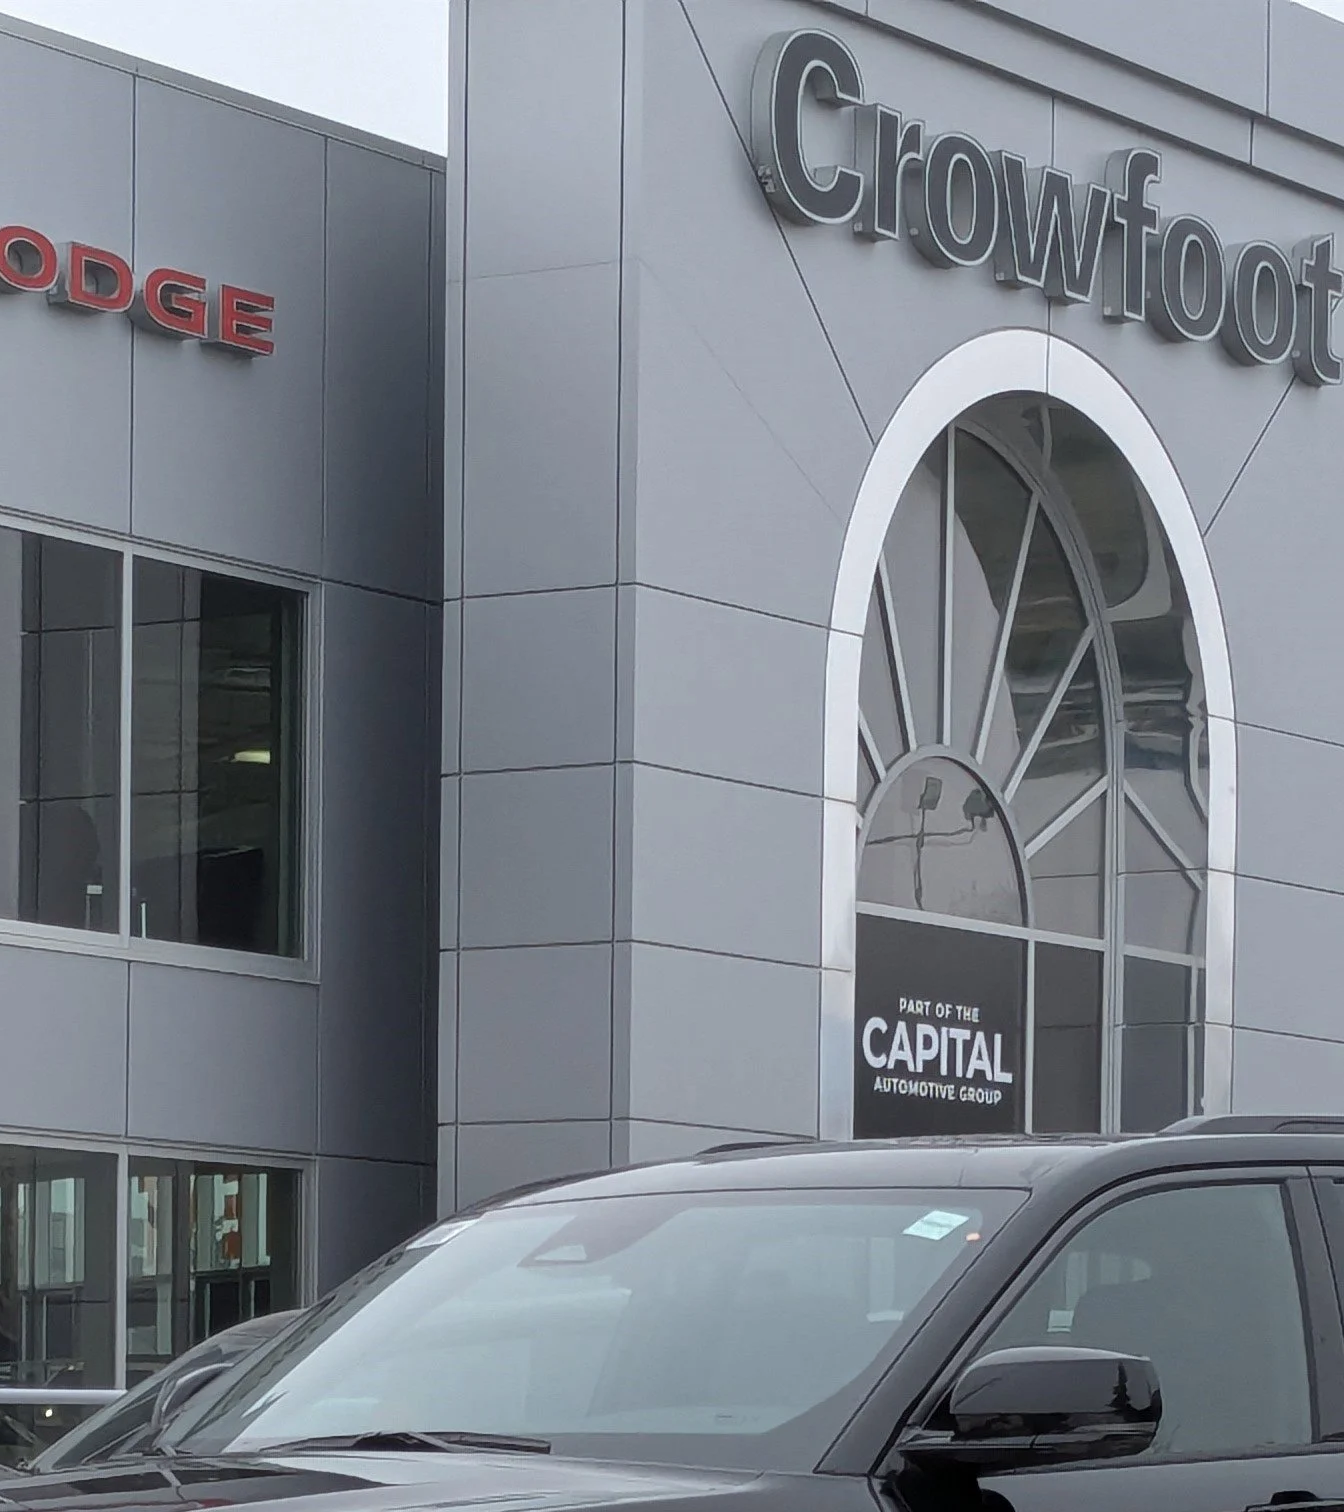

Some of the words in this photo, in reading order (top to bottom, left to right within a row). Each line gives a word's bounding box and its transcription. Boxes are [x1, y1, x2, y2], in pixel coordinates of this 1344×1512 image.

[752, 27, 1344, 386] Crowfoot
[899, 997, 931, 1016] PART
[935, 1002, 953, 1018] OF
[956, 1005, 980, 1023] THE
[862, 1016, 1013, 1084] CAPITAL
[873, 1076, 956, 1101] AUTOMOTIVE
[959, 1085, 1002, 1105] GROUP
